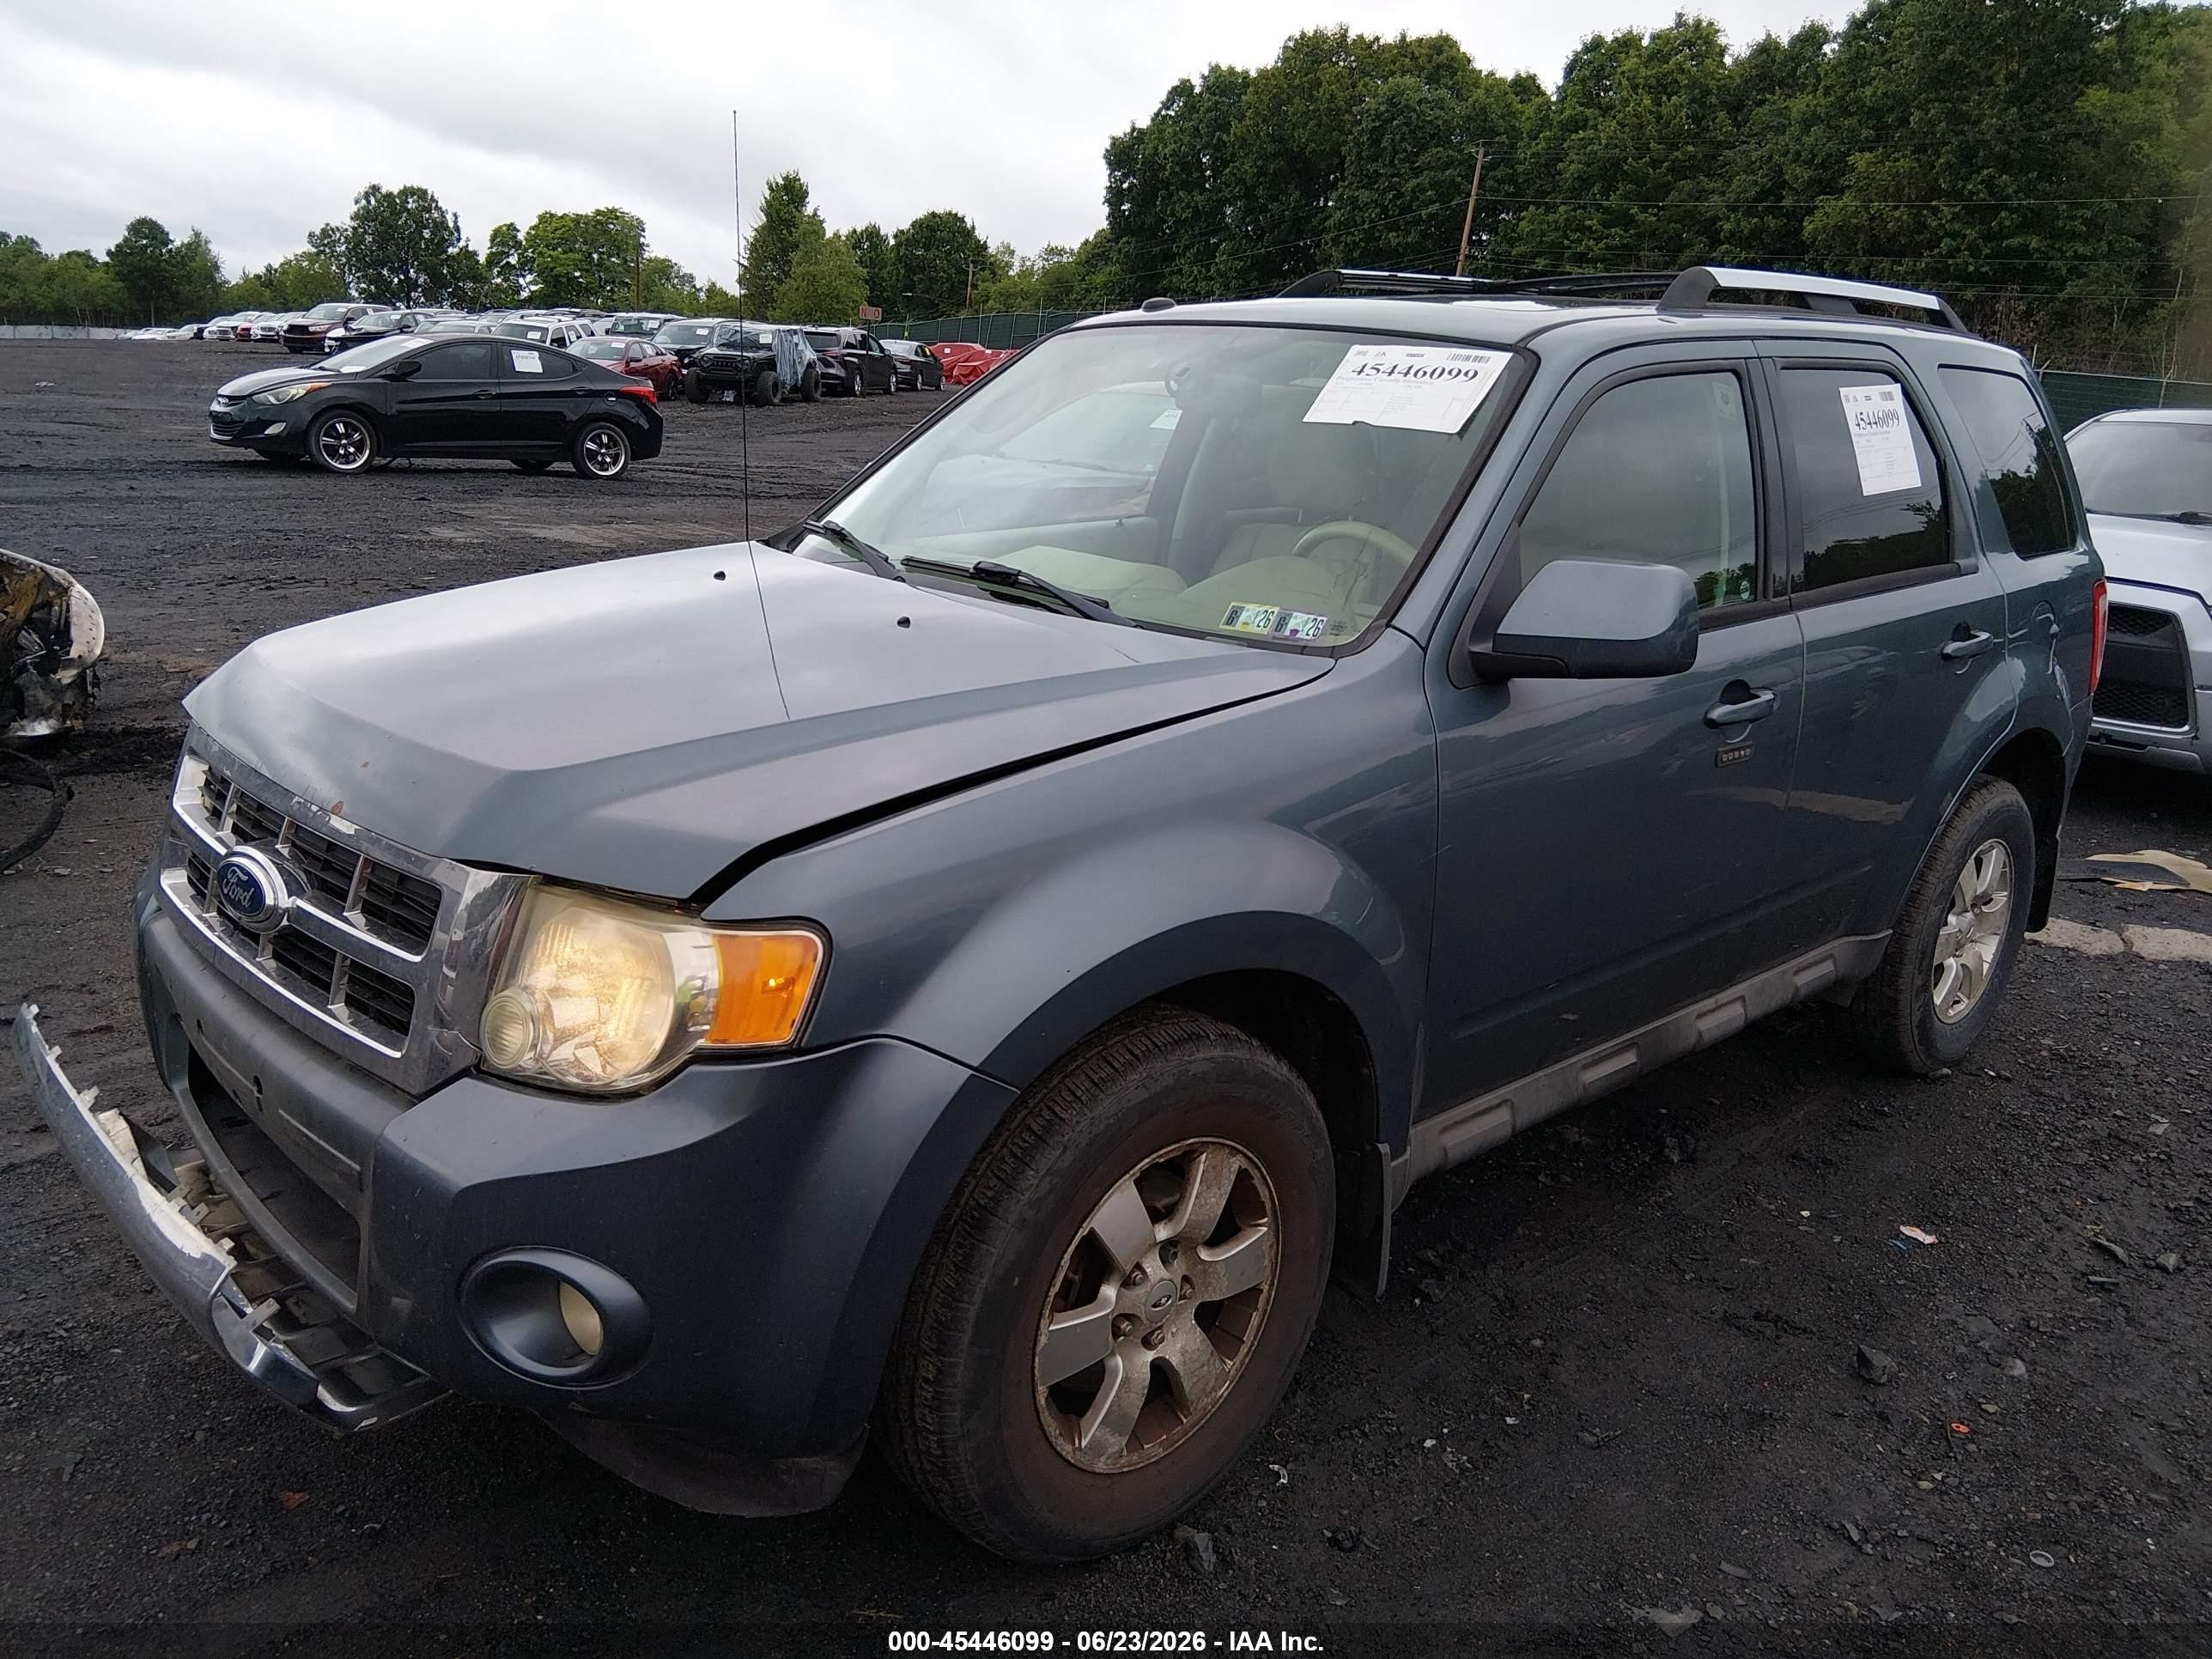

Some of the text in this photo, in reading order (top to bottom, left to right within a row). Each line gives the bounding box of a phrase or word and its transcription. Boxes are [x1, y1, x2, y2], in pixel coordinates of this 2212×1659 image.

[1351, 362, 1479, 383] 45446099
[1854, 408, 1900, 430] 45446099
[1225, 610, 1275, 629] 6 26
[1274, 617, 1286, 633] 6
[1305, 617, 1324, 637] 26
[222, 866, 255, 908] Ford
